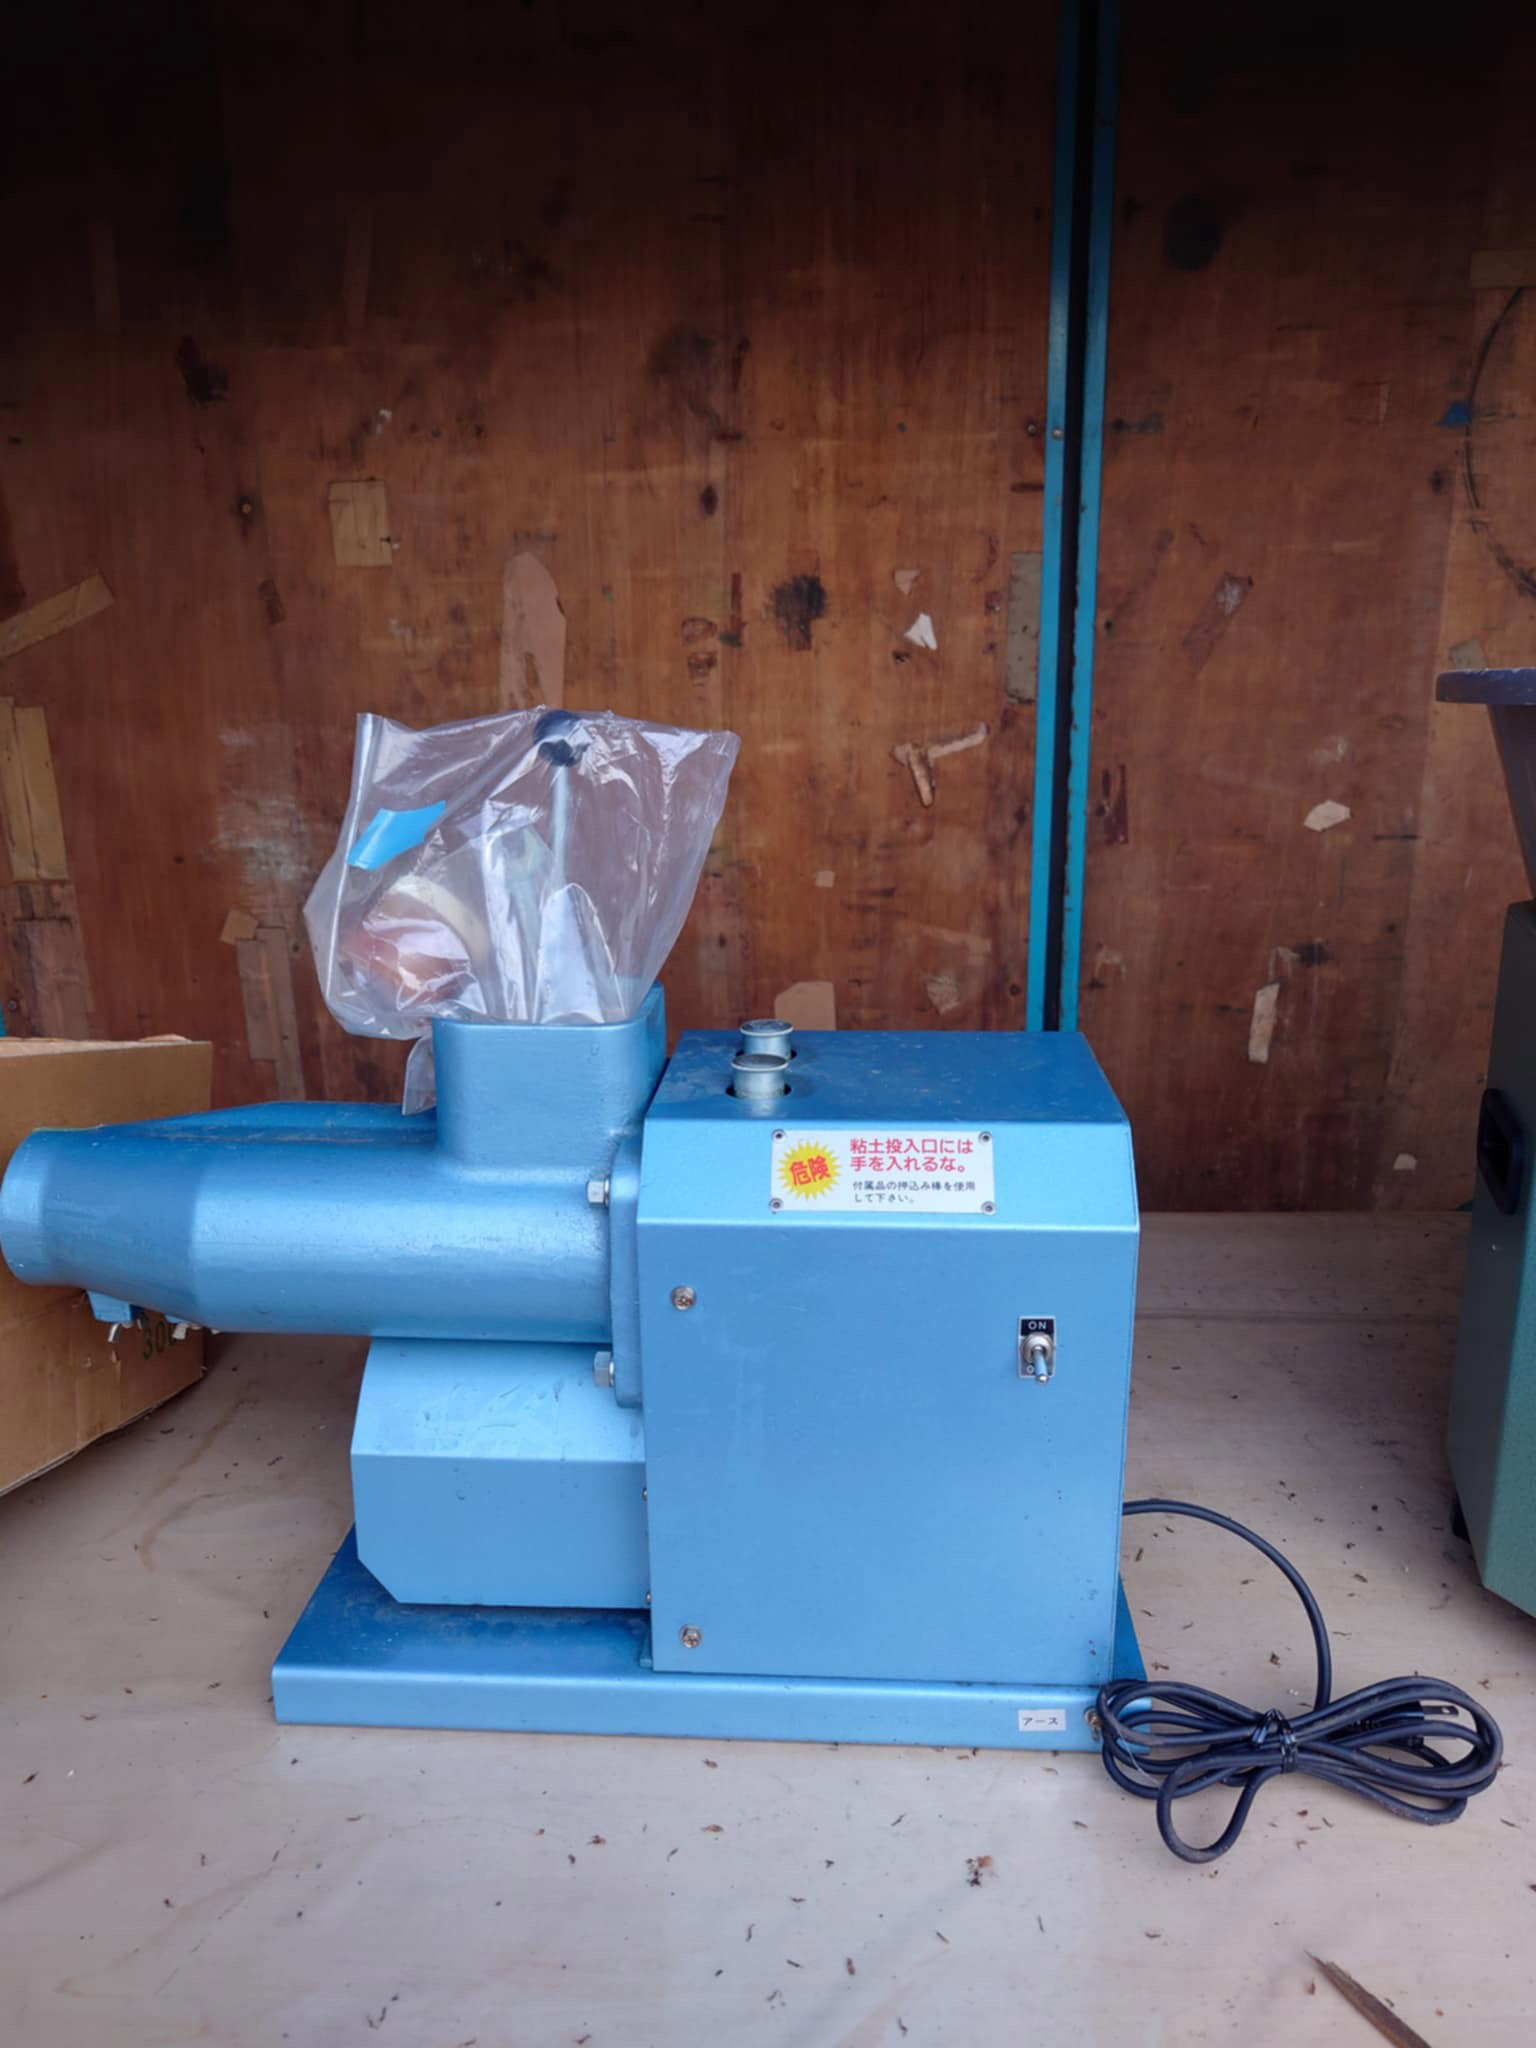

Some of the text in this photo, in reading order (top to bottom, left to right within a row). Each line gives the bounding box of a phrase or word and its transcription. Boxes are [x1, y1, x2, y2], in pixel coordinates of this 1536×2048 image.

[850, 1138, 974, 1154] 粘土投入口には
[789, 1155, 831, 1186] 危険
[850, 1155, 966, 1173] 手を入れるな。
[854, 1192, 915, 1204] して下さい。
[1028, 1320, 1047, 1330] ON
[1023, 1716, 1058, 1726] アース
